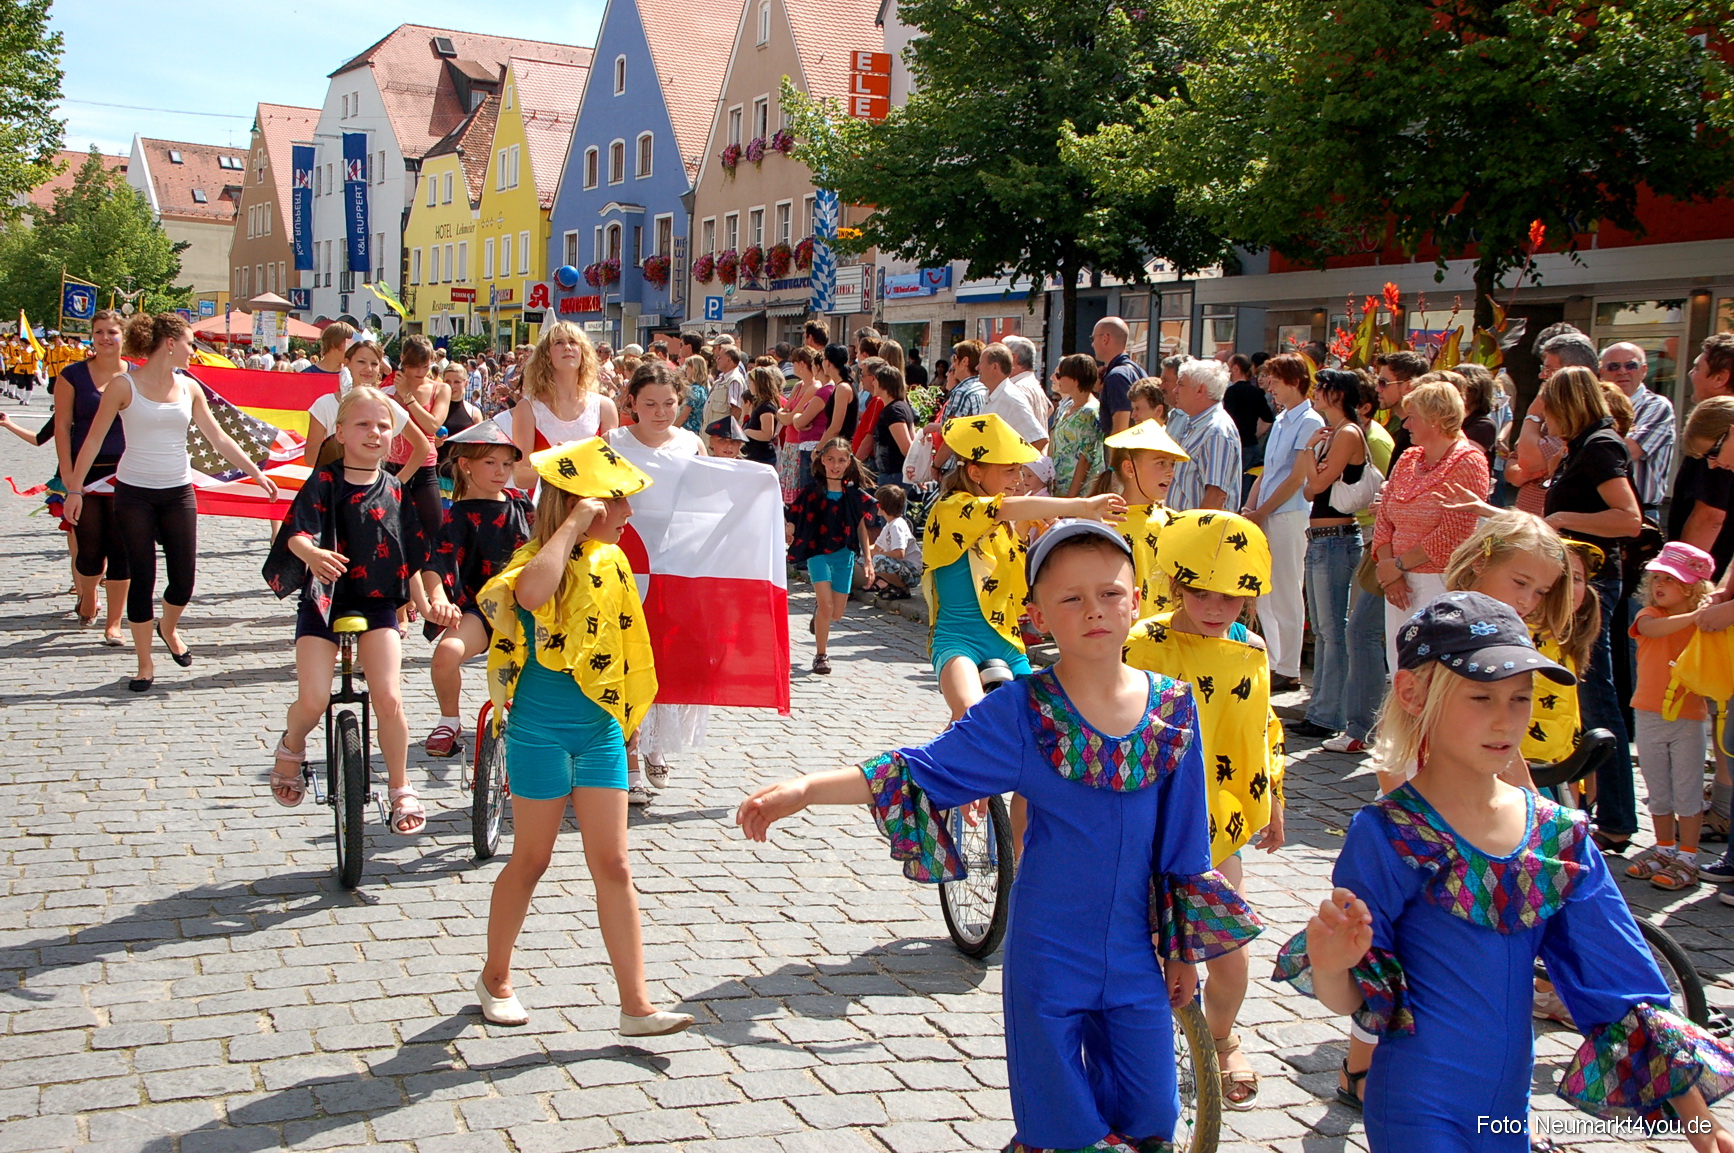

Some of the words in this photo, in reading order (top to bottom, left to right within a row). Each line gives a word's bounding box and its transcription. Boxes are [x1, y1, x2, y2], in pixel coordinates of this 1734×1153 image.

[355, 185, 365, 234] RUPPERT
[435, 223, 452, 240] HOTEL
[358, 235, 366, 256] K&L
[674, 249, 685, 298] WITTL
[851, 284, 856, 294] 2
[432, 300, 456, 312] Restaurant
[708, 298, 719, 318] P
